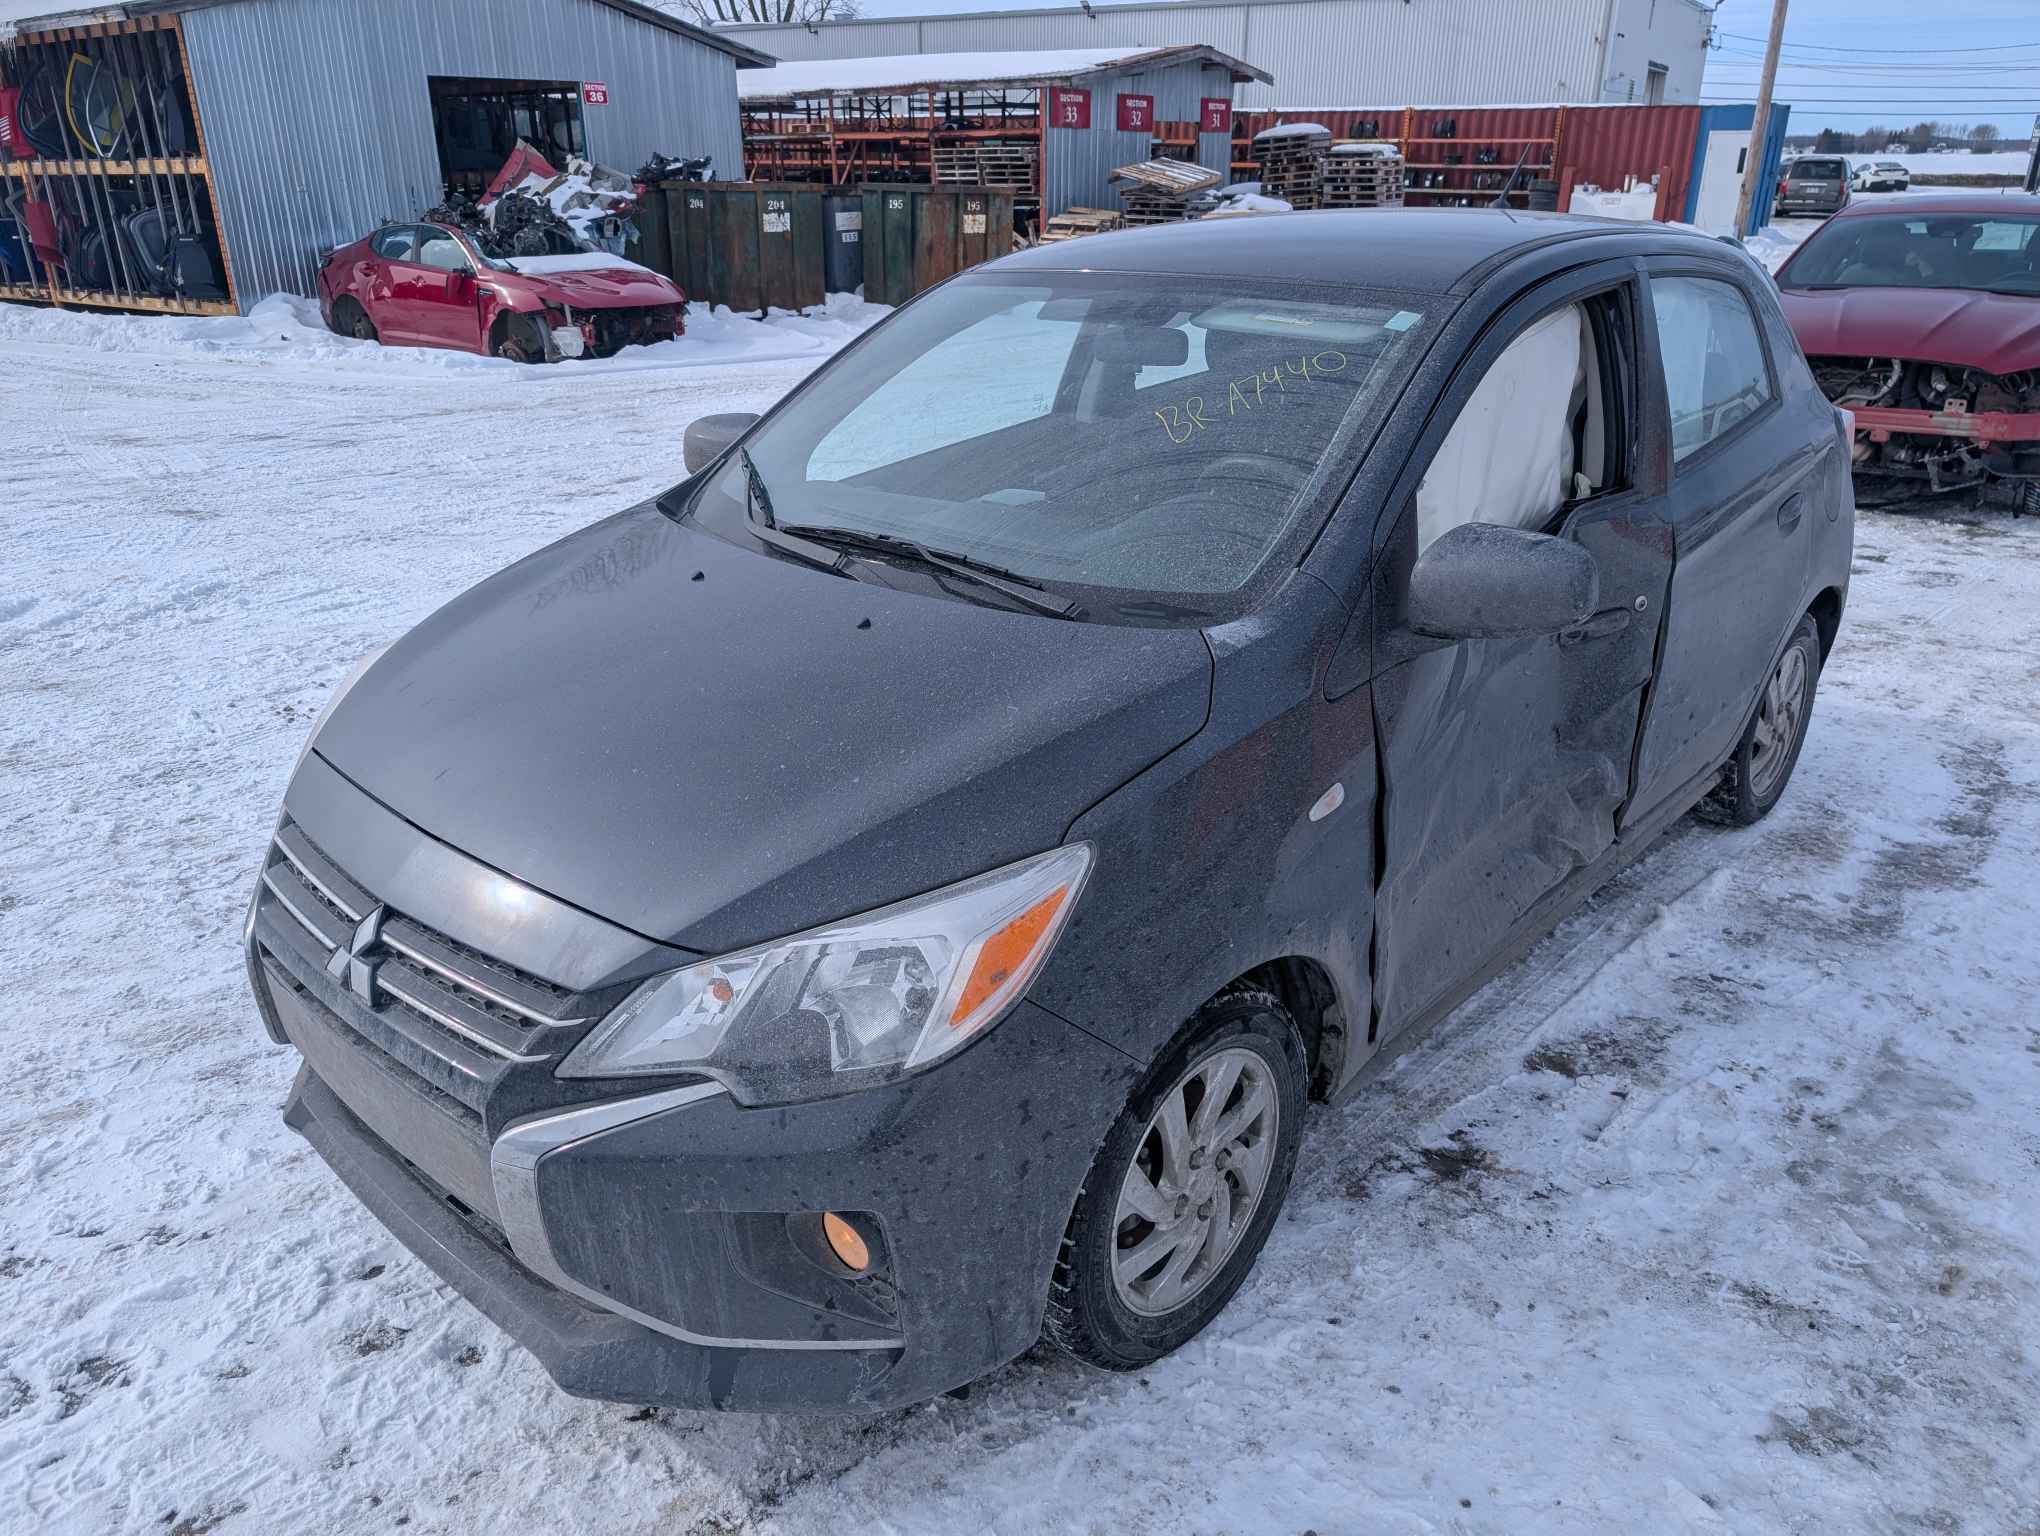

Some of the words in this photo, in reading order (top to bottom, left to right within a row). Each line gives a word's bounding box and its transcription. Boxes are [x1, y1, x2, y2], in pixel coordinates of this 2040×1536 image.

[590, 91, 604, 102] 36
[1060, 94, 1083, 103] SECTION
[1064, 106, 1078, 122] 33
[1131, 110, 1142, 126] 32
[1212, 113, 1220, 128] 31
[689, 199, 704, 208] 204
[767, 200, 785, 210] 204
[889, 199, 904, 209] 195
[967, 201, 981, 211] 195
[1155, 396, 1215, 443] BR
[1228, 350, 1347, 416] A7440
